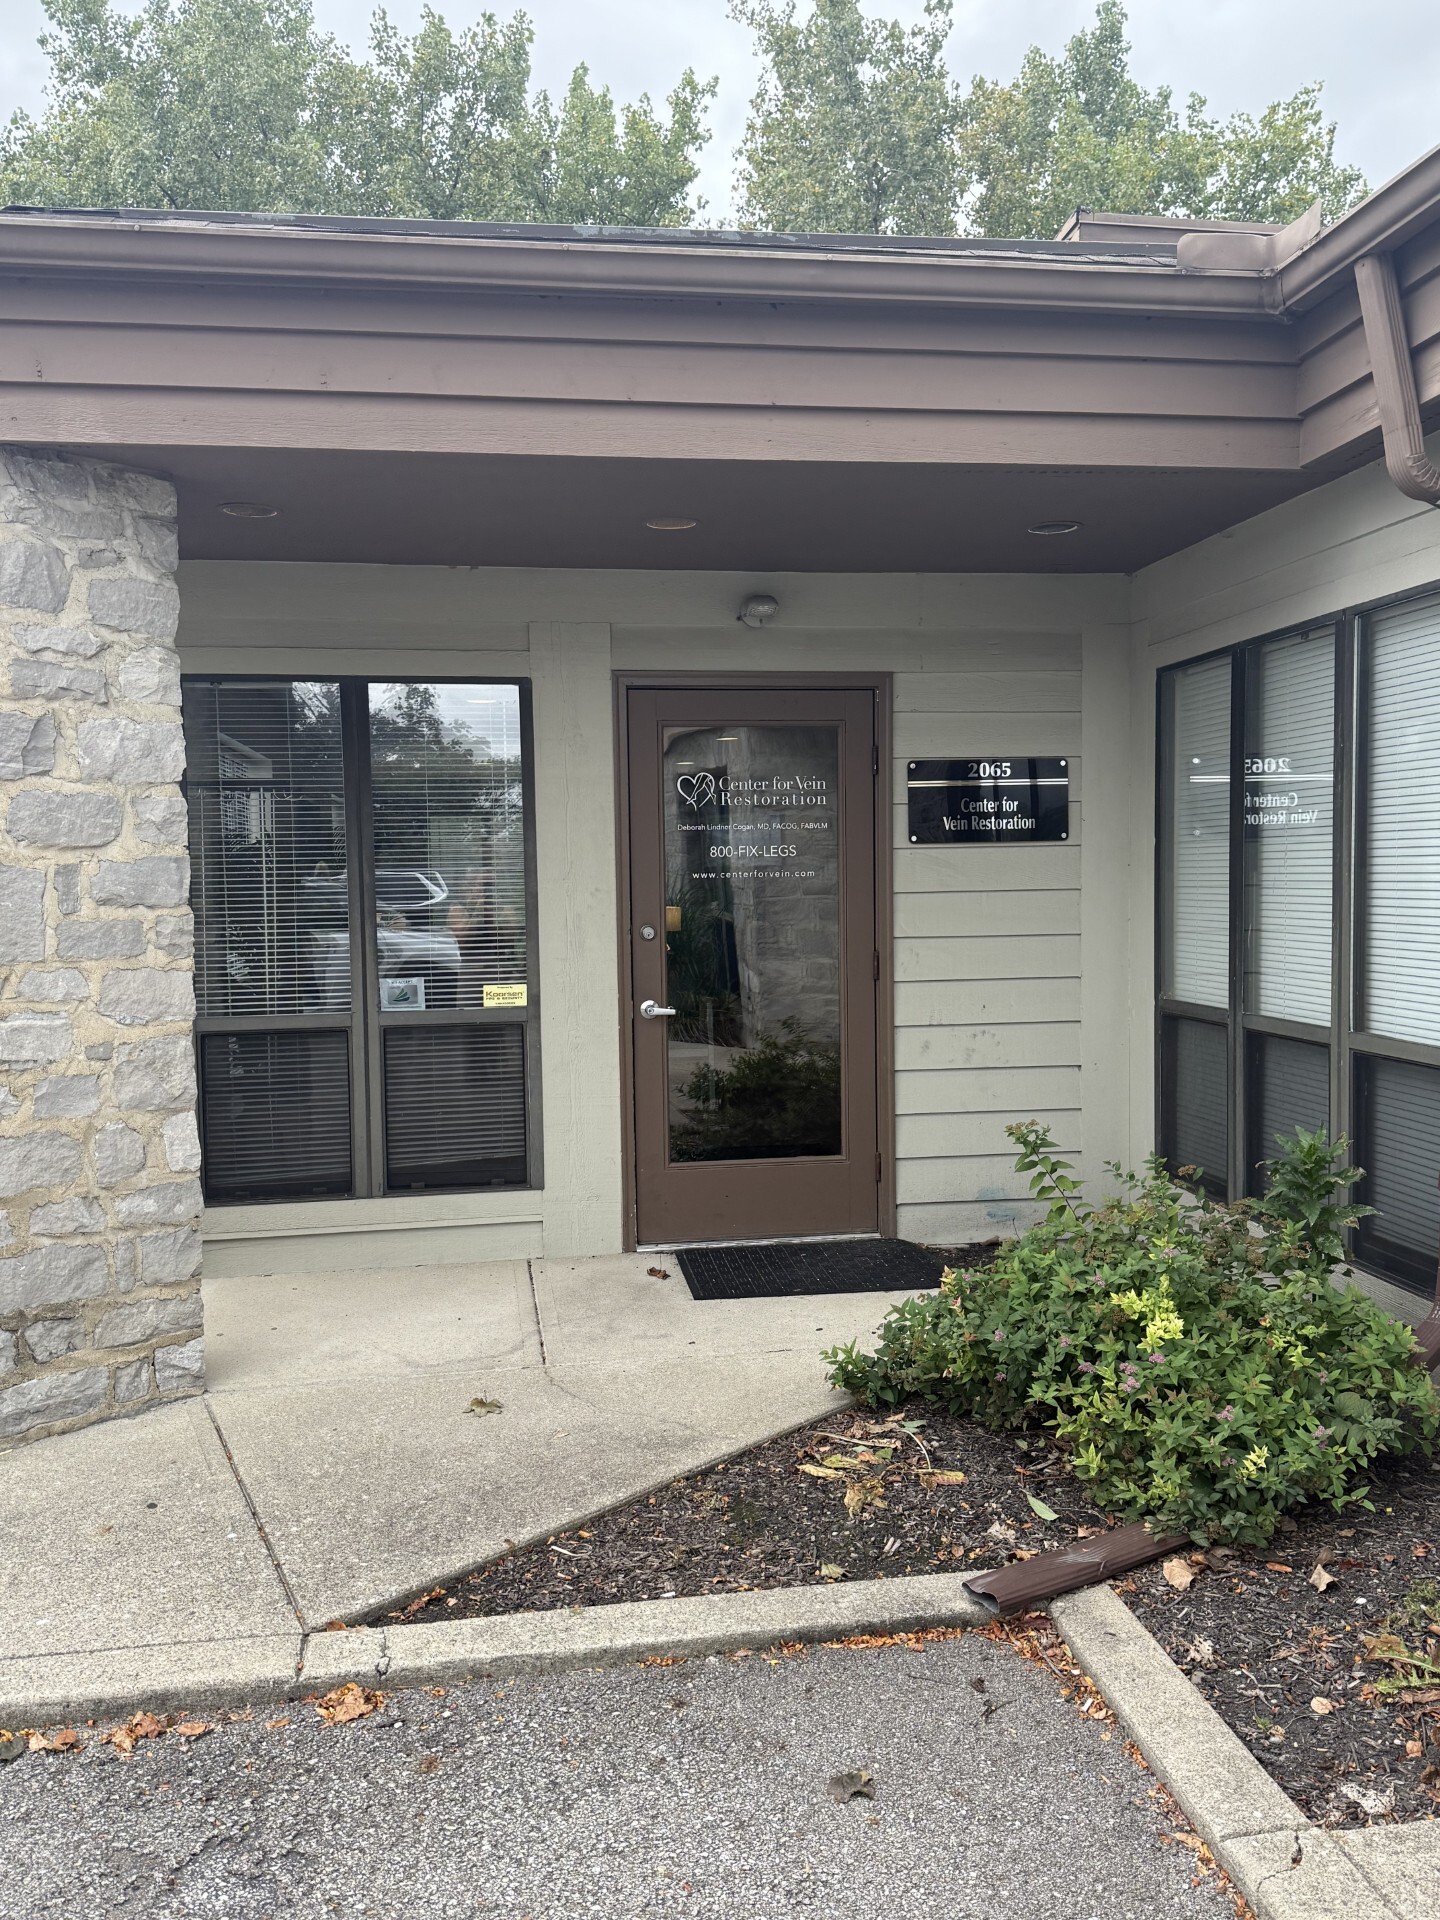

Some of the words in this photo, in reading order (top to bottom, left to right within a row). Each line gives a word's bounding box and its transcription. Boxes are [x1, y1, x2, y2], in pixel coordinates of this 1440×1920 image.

[967, 762, 1012, 778] 2065
[719, 776, 768, 791] Center
[773, 776, 793, 790] for
[795, 776, 827, 790] Vein
[720, 791, 827, 806] Restoration
[961, 798, 1000, 812] Center
[1002, 796, 1019, 812] for
[732, 823, 756, 831] Cogan,
[772, 822, 799, 830] FACOG,
[943, 814, 968, 830] Vein
[971, 814, 1036, 830] Restoration
[709, 845, 797, 858] 800-FIX-LEGS
[692, 869, 815, 879] www.centerforvein.com
